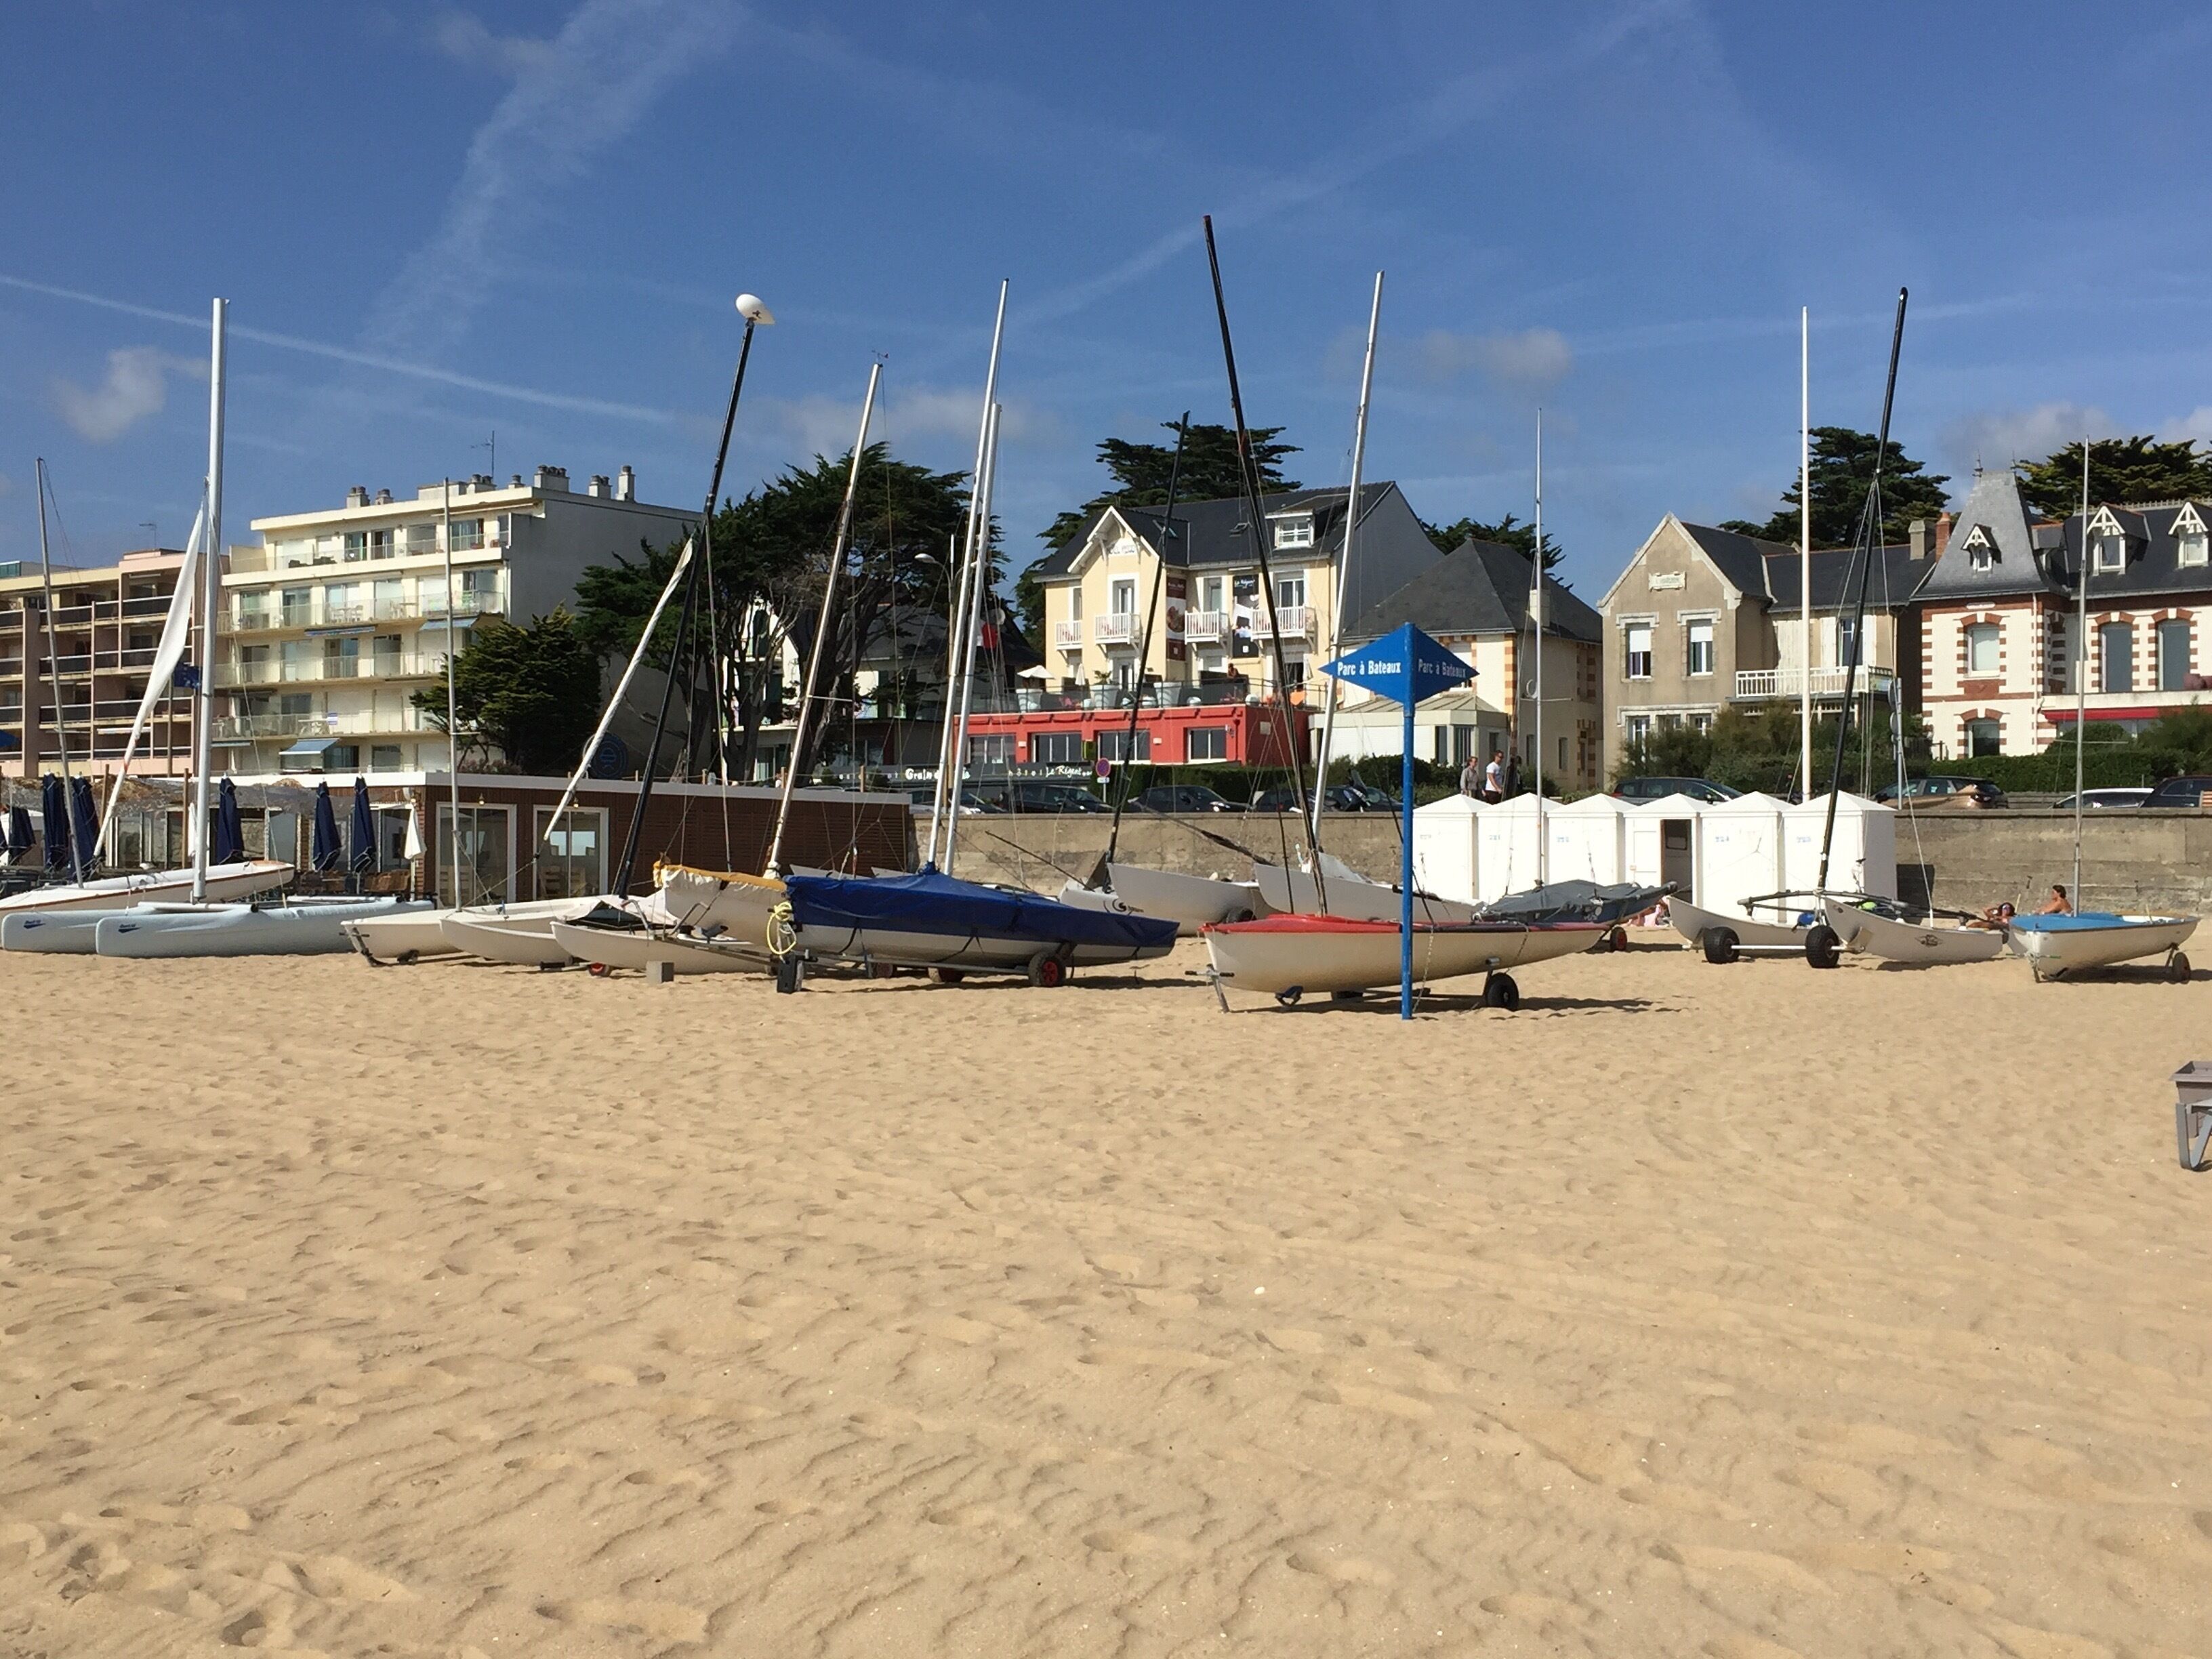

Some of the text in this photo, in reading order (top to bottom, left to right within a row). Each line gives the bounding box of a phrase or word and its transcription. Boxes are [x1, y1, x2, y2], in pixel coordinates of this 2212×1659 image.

[1338, 660, 1401, 676] Parc à Bateaux
[1418, 659, 1433, 674] Parc
[1441, 661, 1467, 678] Bateaux
[905, 768, 933, 780] Grain
